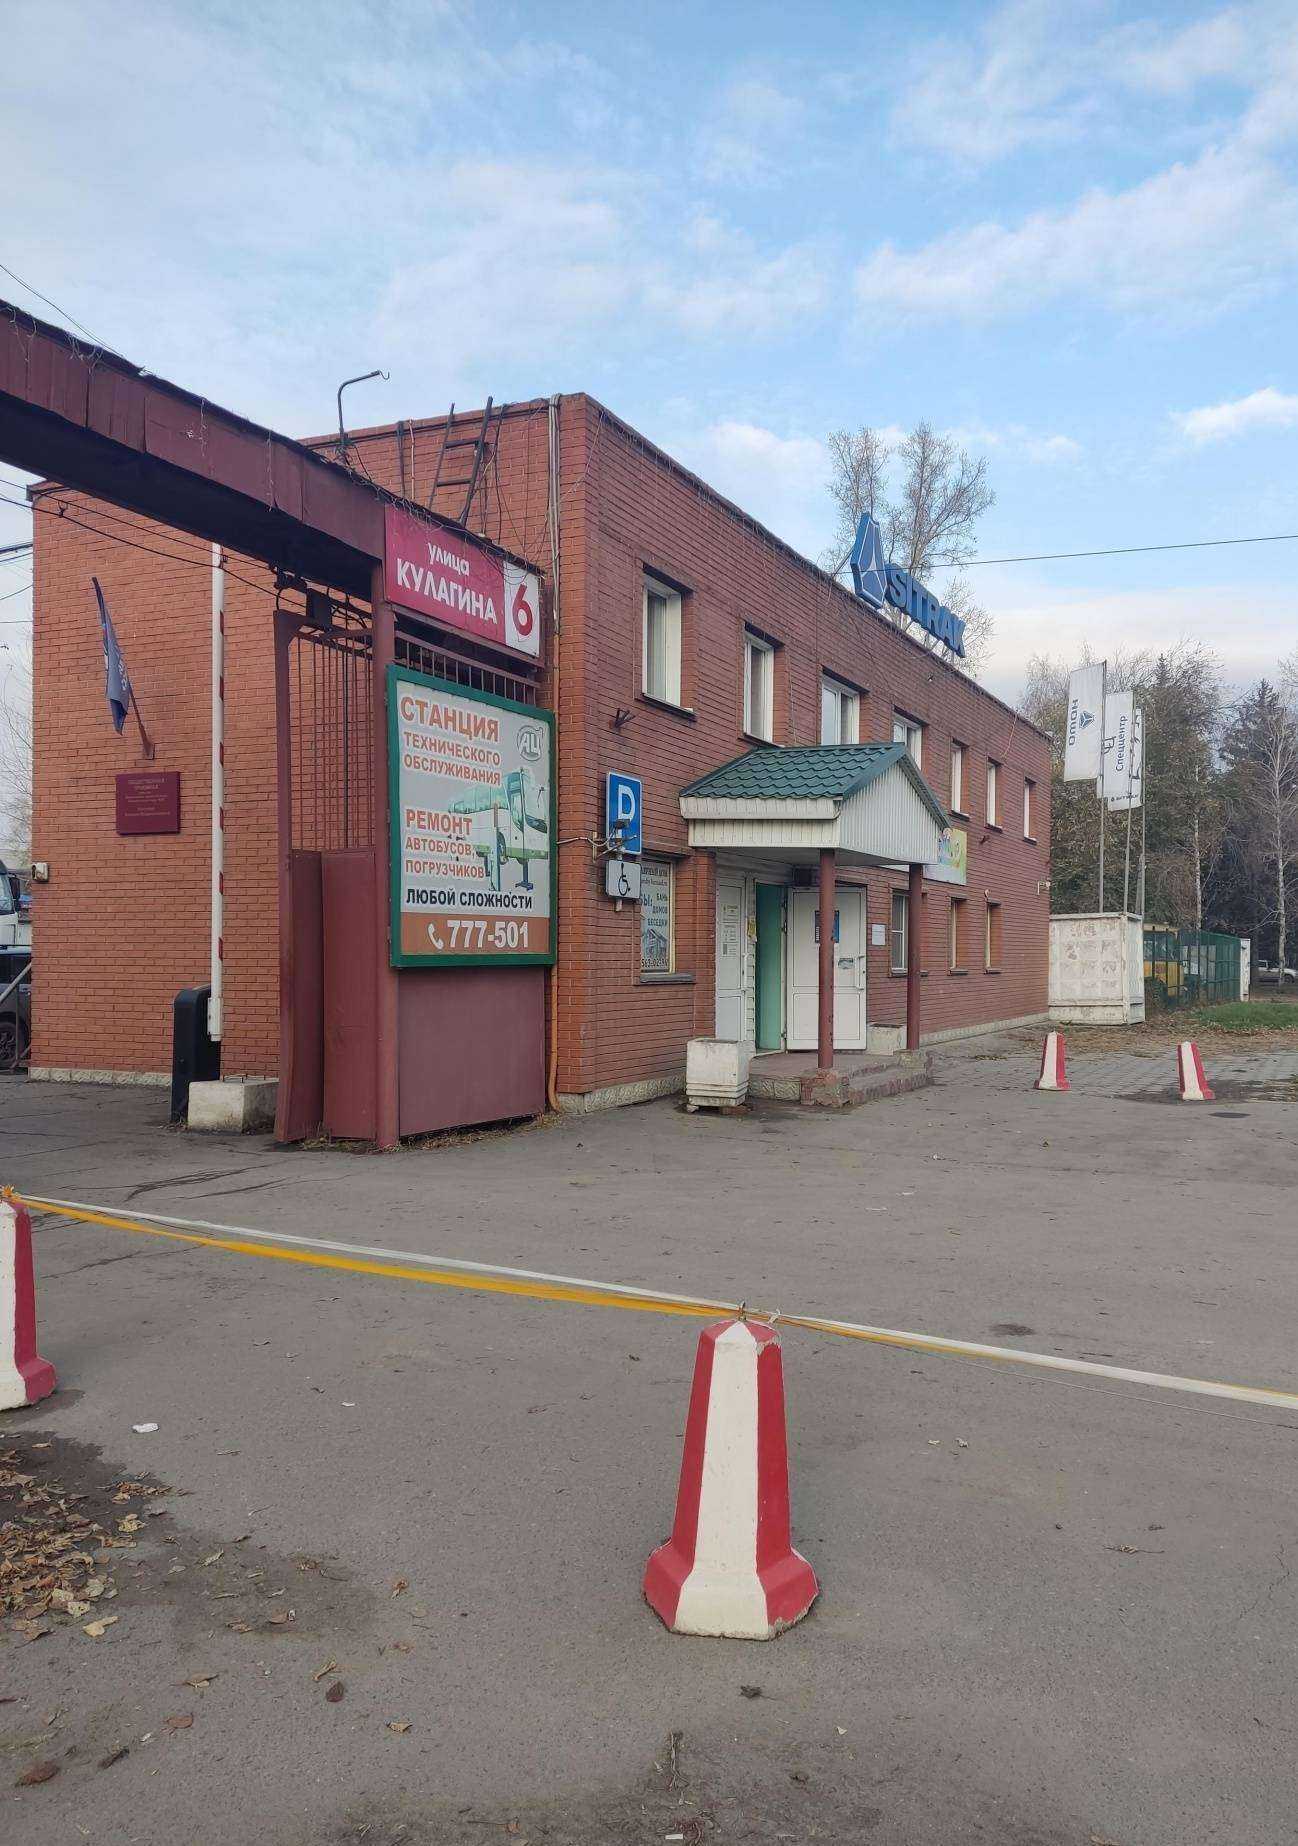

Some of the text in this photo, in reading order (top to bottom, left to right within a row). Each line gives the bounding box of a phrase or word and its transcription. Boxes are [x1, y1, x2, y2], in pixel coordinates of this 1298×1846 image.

[397, 558, 498, 625] КУЛАГИНА
[513, 583, 533, 637] 6
[401, 696, 500, 743] СТАНЦИЯ
[404, 731, 501, 766] ТЕХНИЧЕСКОГО
[404, 754, 501, 787] ОБСЛУЖИВАНИЯ
[406, 808, 473, 836] РЕМОНТ
[405, 836, 475, 860] АВТОБУСОВ,
[405, 859, 486, 879] ПОГРУЗЧИКОВ
[406, 888, 533, 910] ЛЮБОЙ СЛОЖНОСТИ
[446, 920, 529, 949] 777-501
